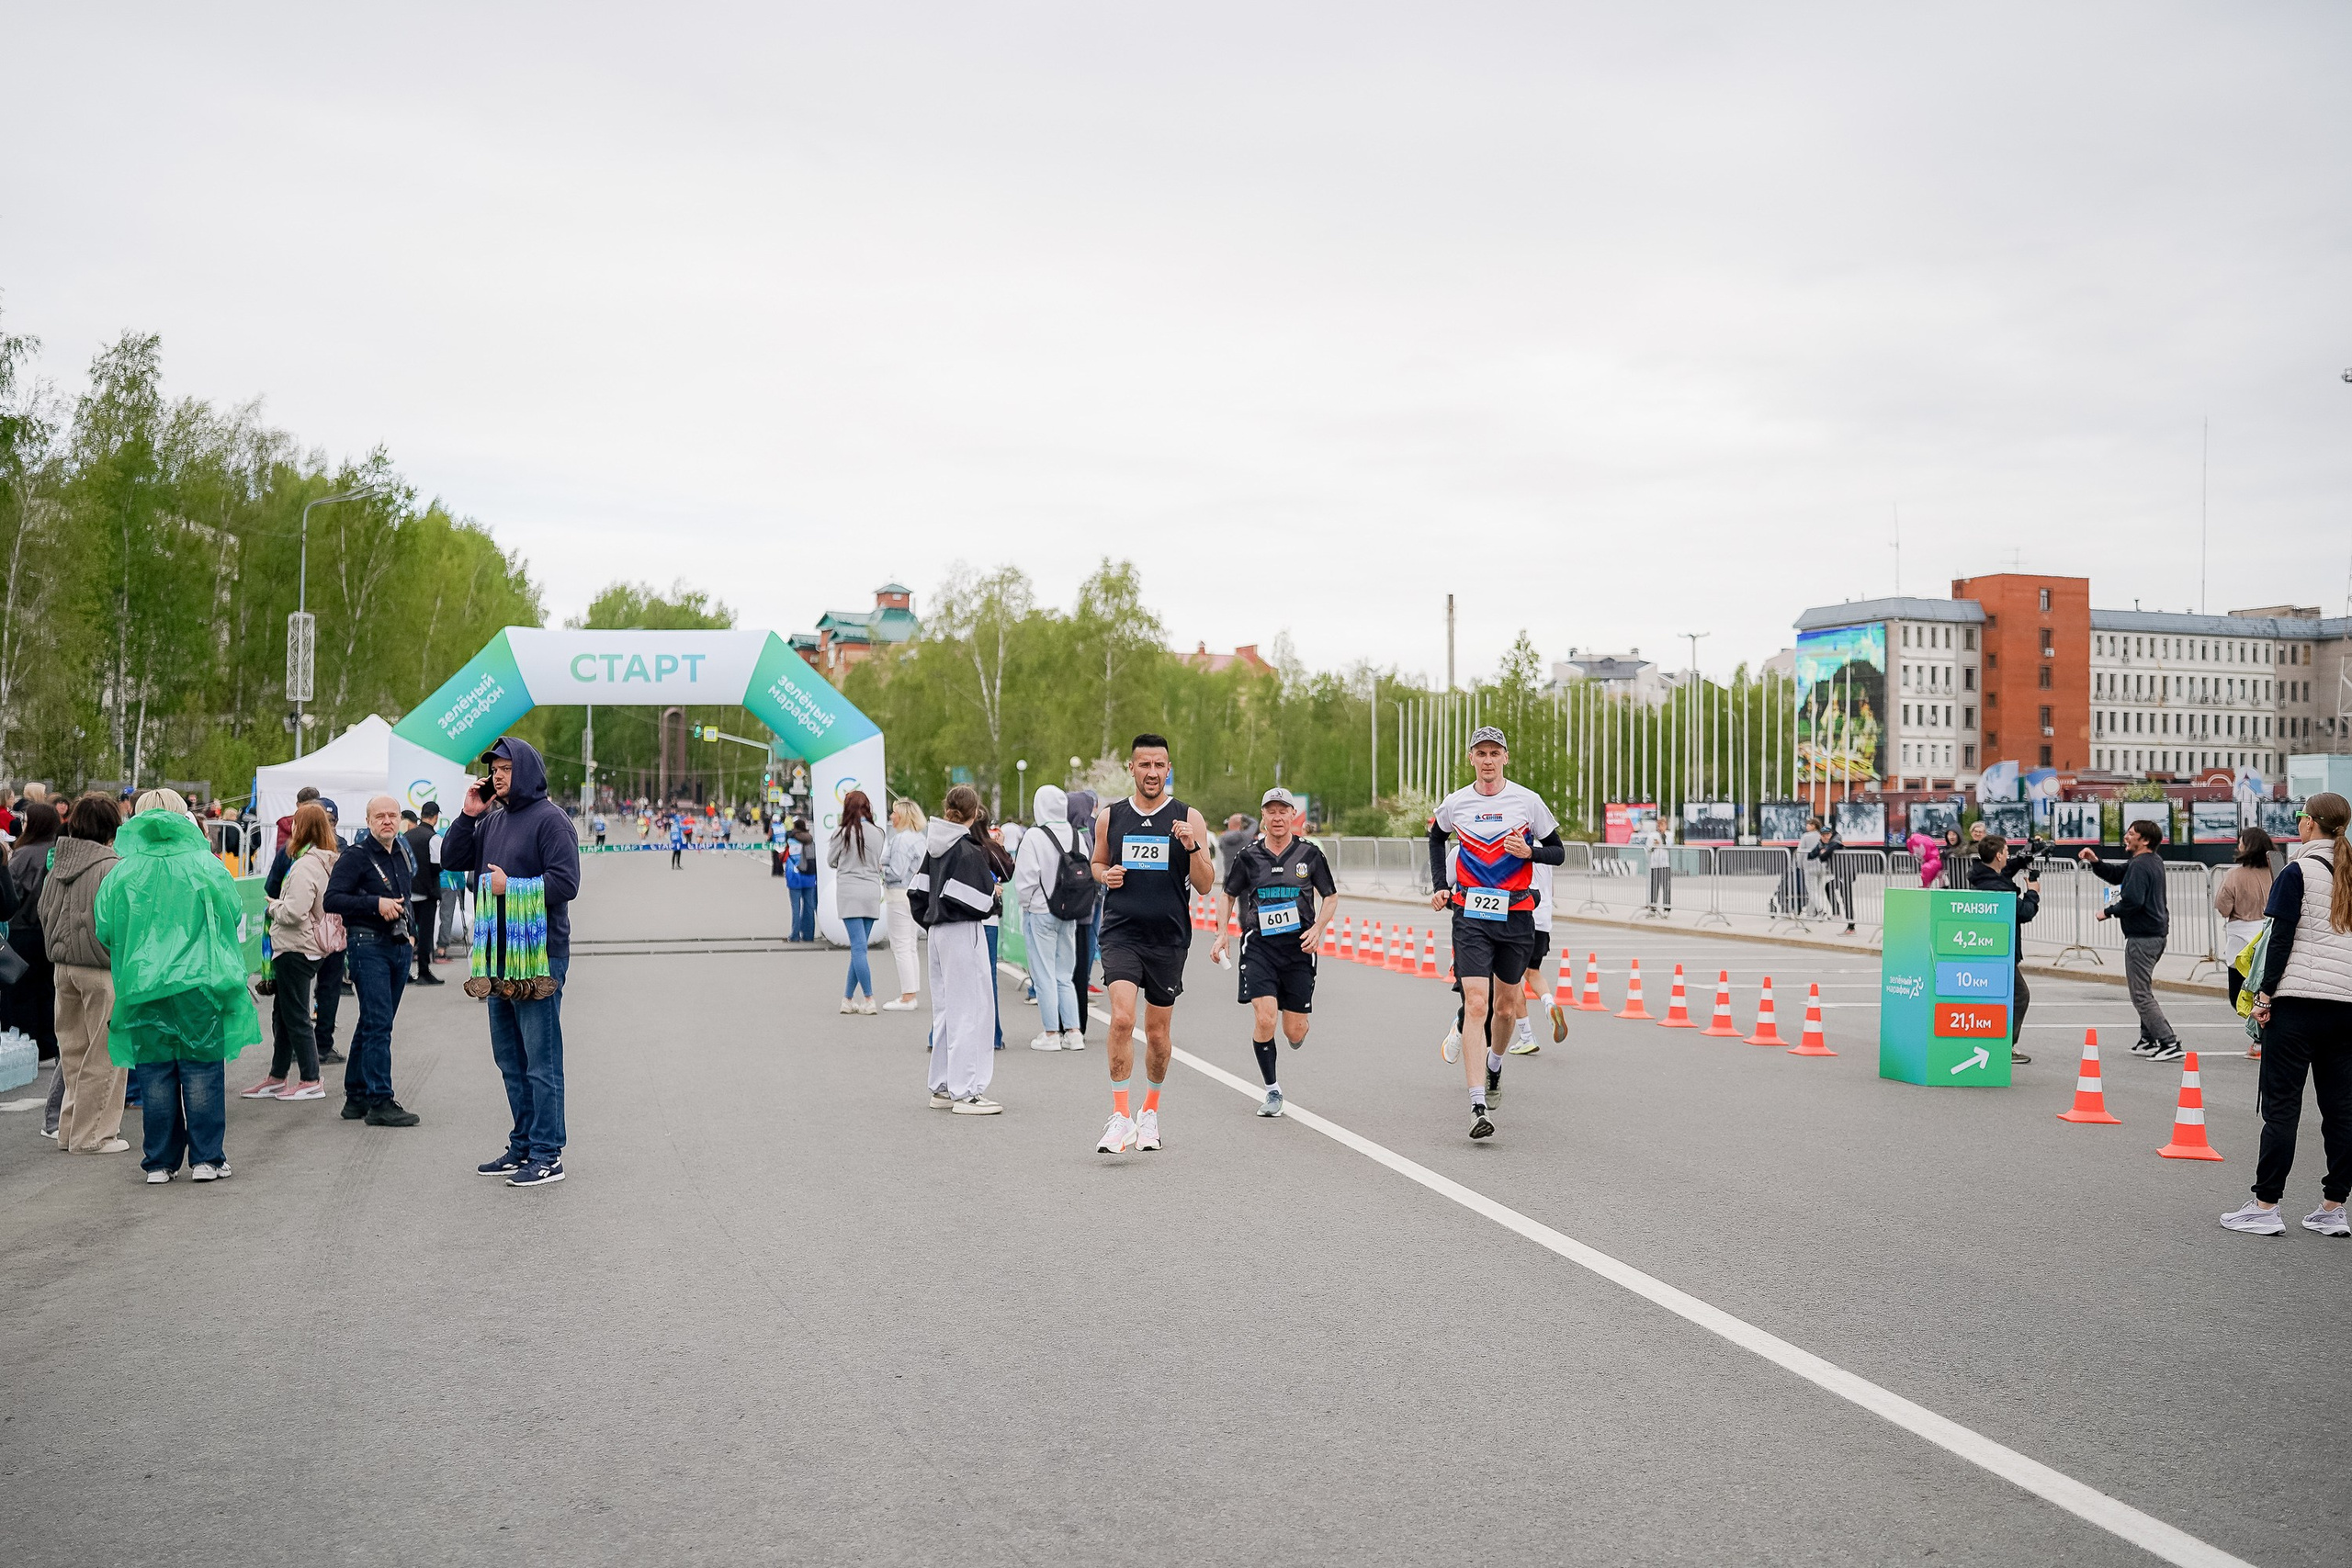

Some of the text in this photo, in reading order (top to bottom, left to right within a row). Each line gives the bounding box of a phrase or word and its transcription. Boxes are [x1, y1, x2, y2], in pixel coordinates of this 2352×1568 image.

[570, 653, 706, 683] СТАРТ
[437, 672, 496, 729] зелёный
[767, 684, 825, 739] марафон
[777, 674, 836, 728] зелёный
[447, 685, 505, 740] марафон
[1131, 845, 1159, 859] 728
[1474, 896, 1500, 911] 922
[1951, 901, 1999, 915] ТРАНЗИТ
[1267, 911, 1290, 926] 601
[1956, 972, 1973, 987] 10
